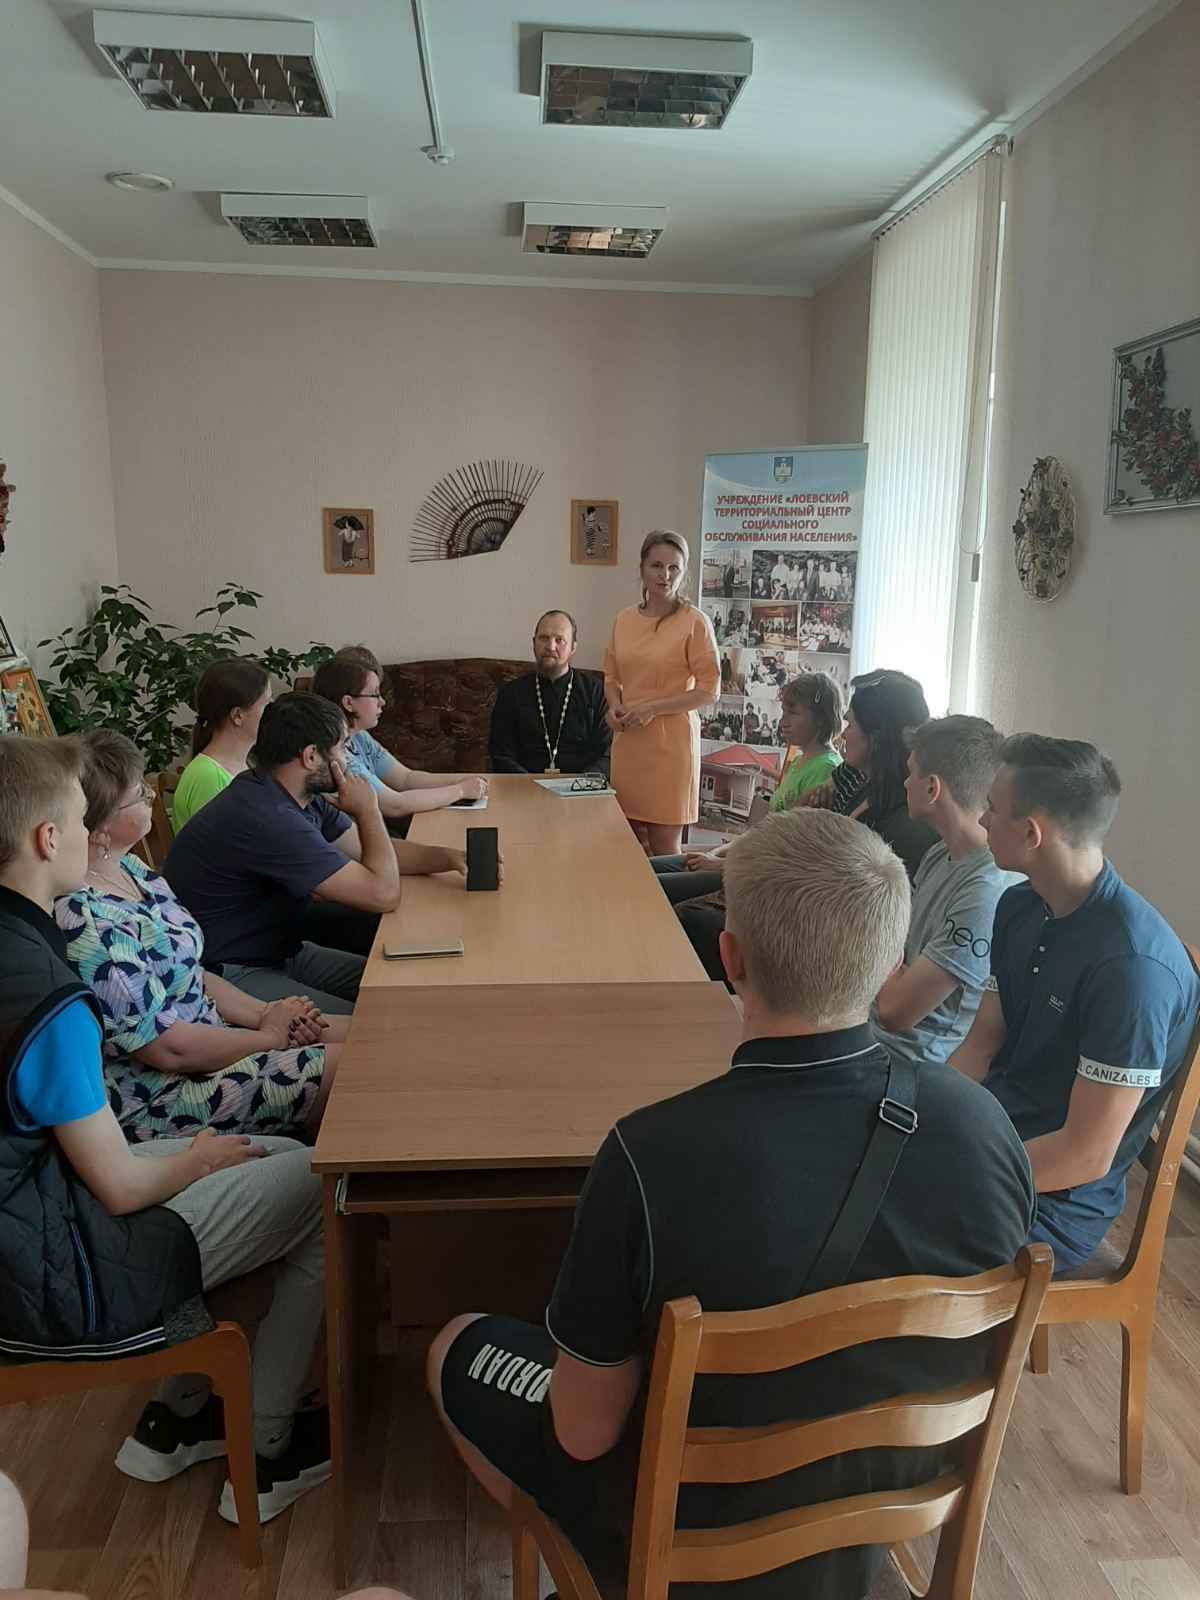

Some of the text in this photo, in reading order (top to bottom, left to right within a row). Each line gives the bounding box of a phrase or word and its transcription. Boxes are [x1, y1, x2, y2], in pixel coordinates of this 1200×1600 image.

[716, 490, 849, 507] УЧРЕЖДЕНИЕ «ЛОЕВСКИЙ
[714, 504, 851, 518] ТЕРРИТОРИАЛЬНЫЙ ЦЕНТР
[741, 519, 819, 531] СОЦИАЛЬНОГО
[704, 532, 857, 542] ОБСЛУЖИВАНИЯ НАСЕЛЕНИЯ»
[943, 917, 990, 958] neo
[1085, 1064, 1151, 1086] CANIZALES
